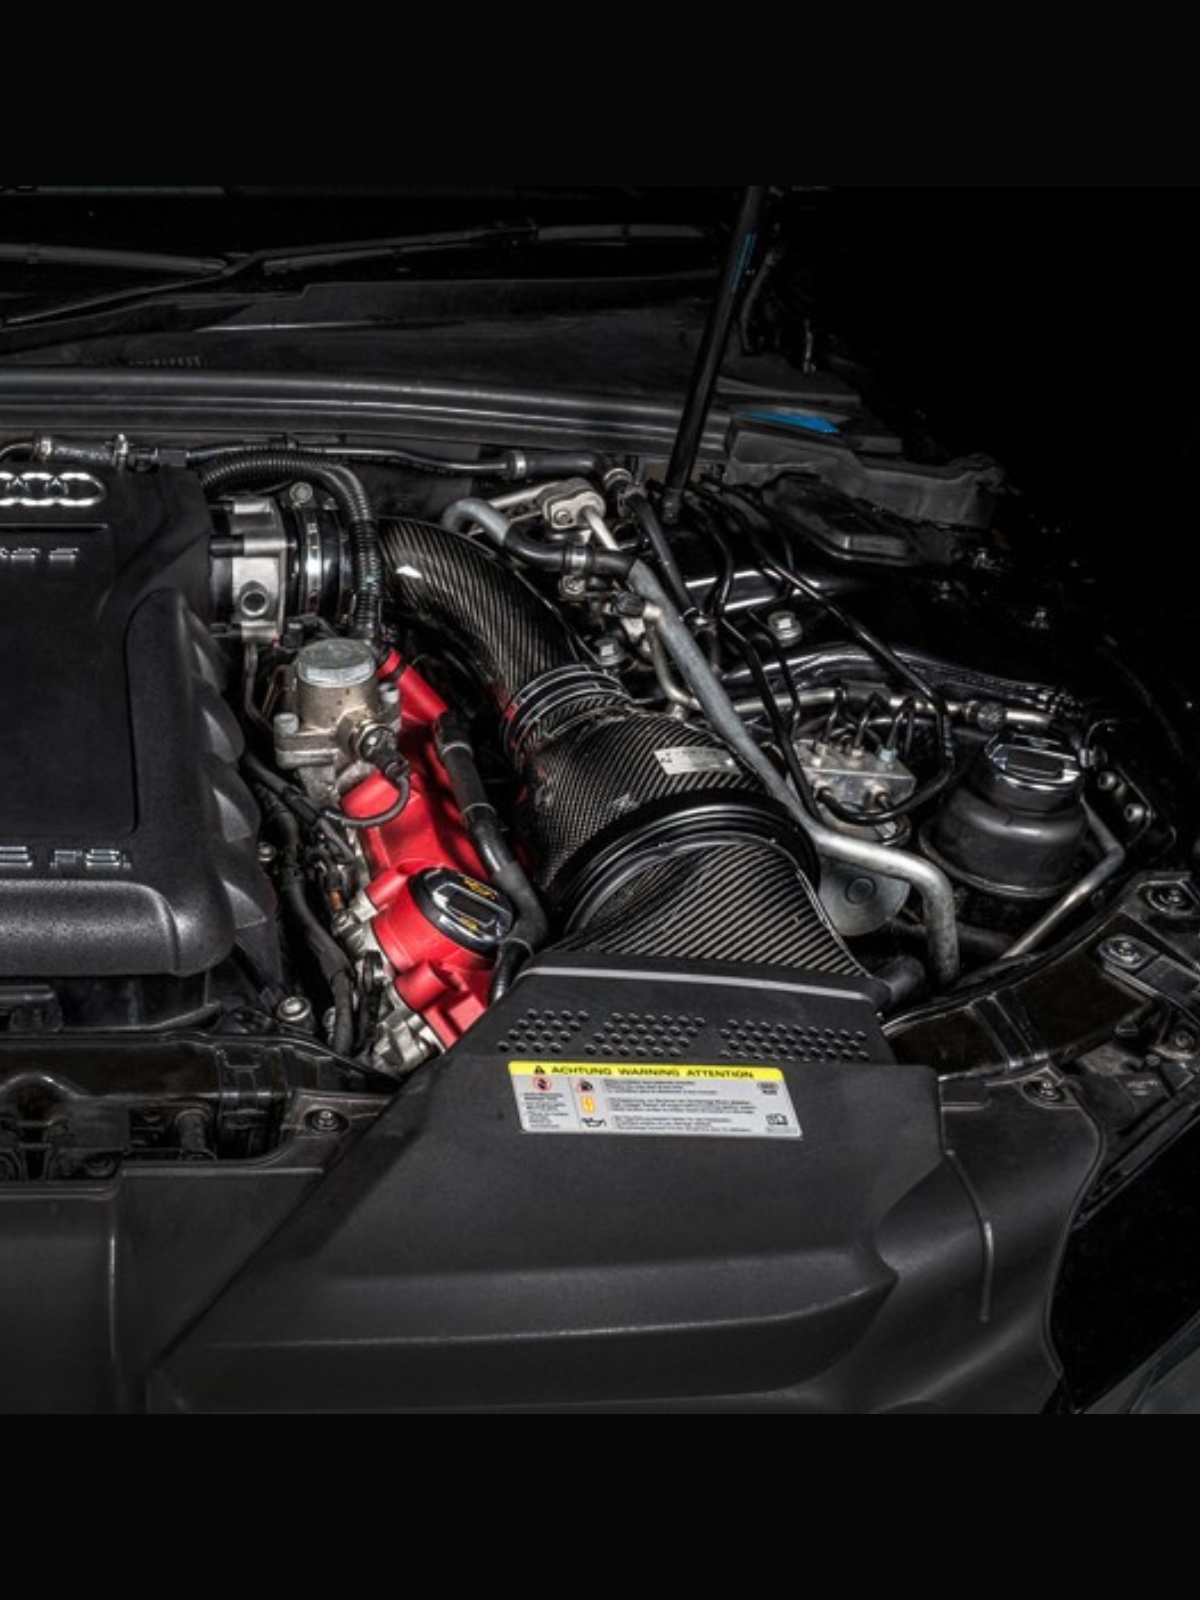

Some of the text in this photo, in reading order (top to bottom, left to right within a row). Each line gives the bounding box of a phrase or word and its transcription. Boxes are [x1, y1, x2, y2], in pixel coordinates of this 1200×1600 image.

[551, 1066, 755, 1079] ACHTUNG WARNING ATTENTION
